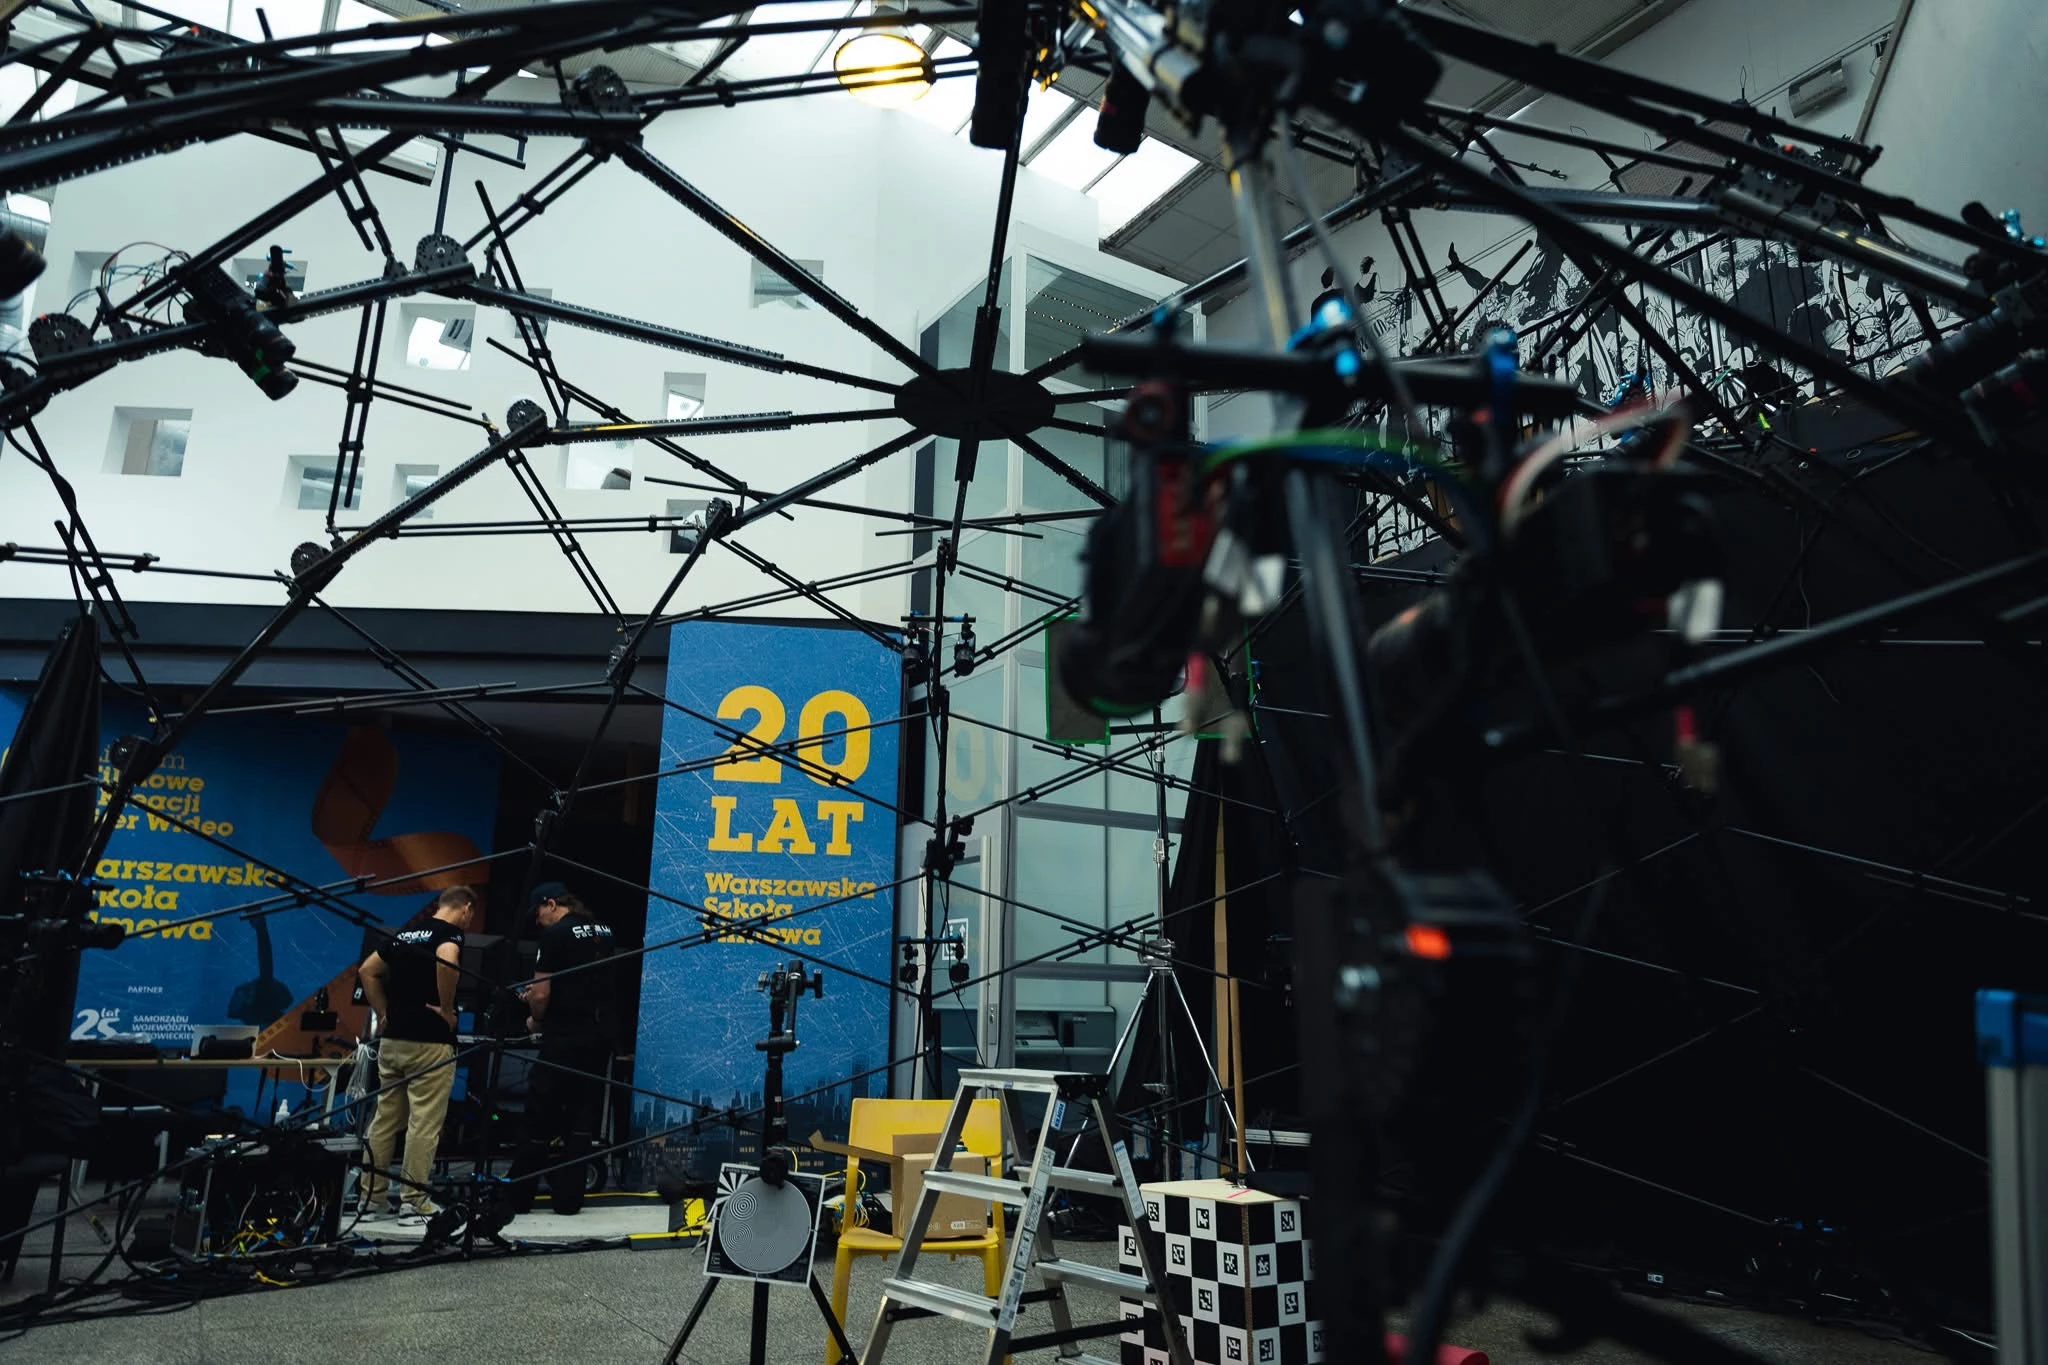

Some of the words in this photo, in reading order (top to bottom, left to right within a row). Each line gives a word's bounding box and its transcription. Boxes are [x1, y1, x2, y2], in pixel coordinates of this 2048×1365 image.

[713, 685, 871, 788] 20
[708, 796, 864, 856] LAT
[95, 858, 287, 889] arszawska
[704, 872, 877, 899] Warszawska
[128, 985, 164, 994] PARTNER
